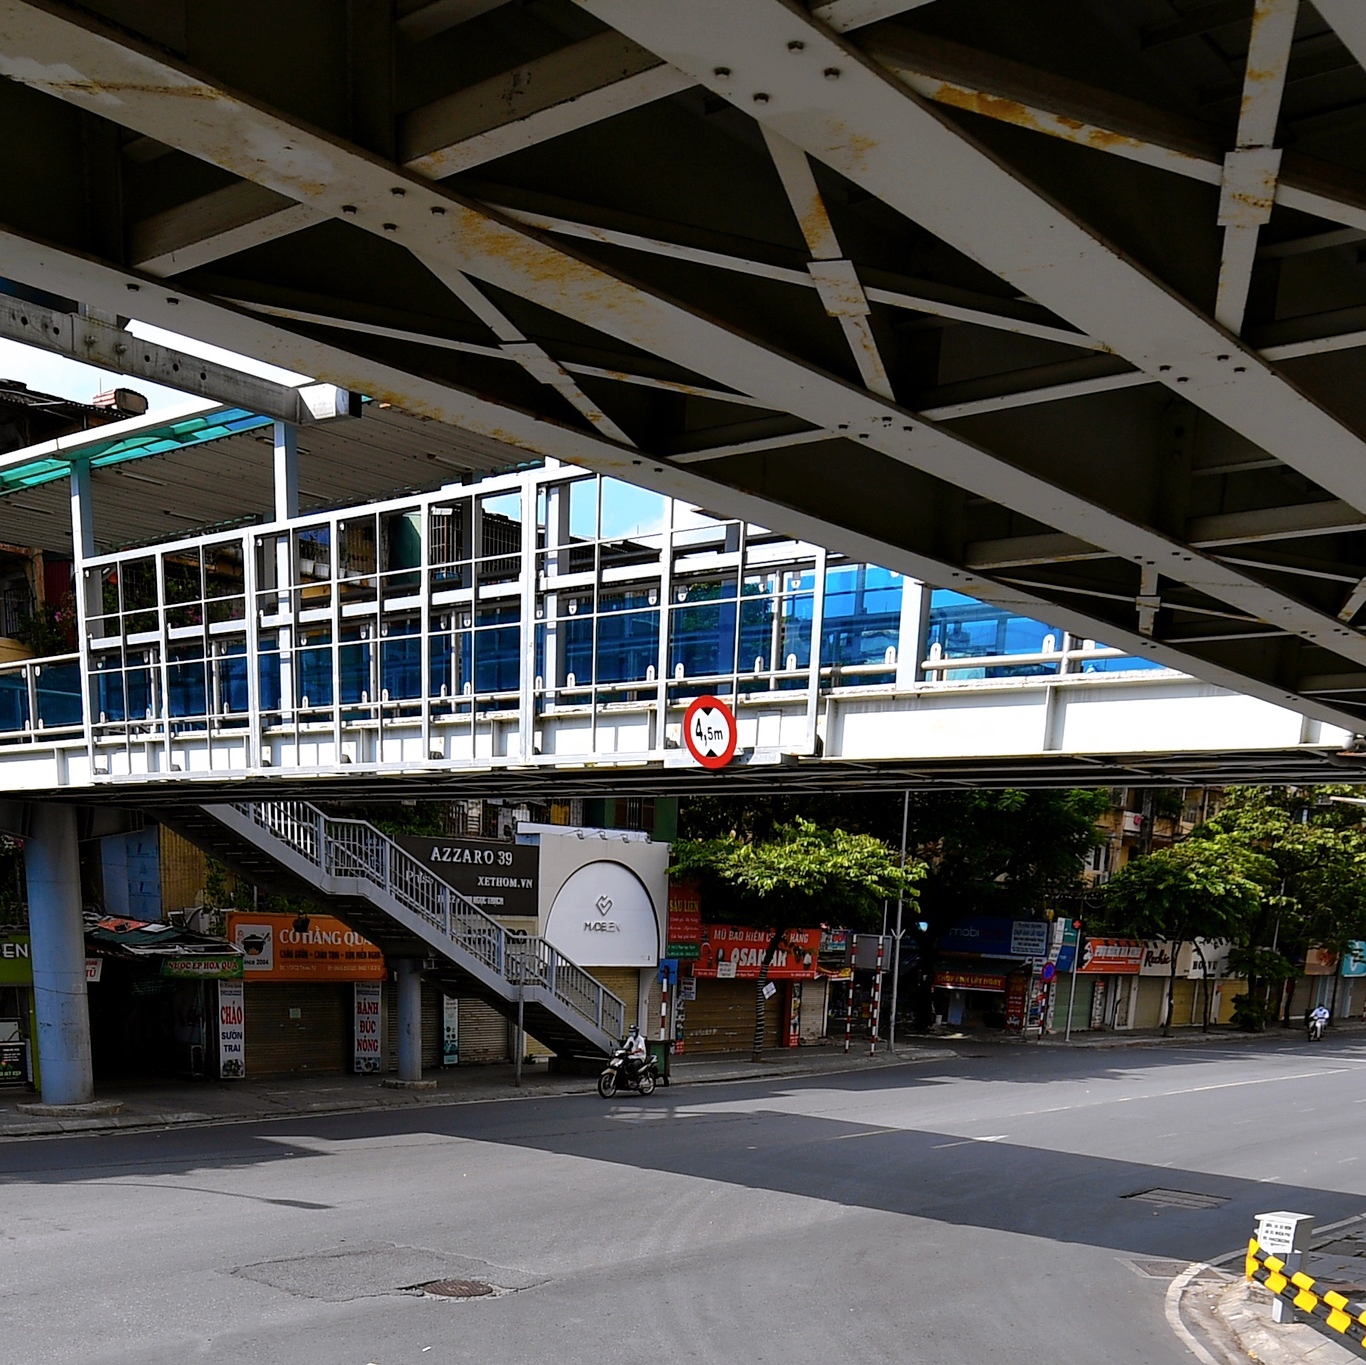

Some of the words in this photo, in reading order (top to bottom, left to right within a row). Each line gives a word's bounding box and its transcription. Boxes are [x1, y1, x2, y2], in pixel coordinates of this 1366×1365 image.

[695, 717, 724, 747] 4,5m
[430, 846, 495, 866] AZZARO
[496, 850, 514, 867] 39
[477, 875, 534, 889] XETHOM.VN
[220, 1001, 243, 1025] CHÁO
[357, 998, 378, 1015] BÁNH
[359, 1016, 376, 1034] ĐÚC
[223, 1043, 241, 1053] TRAI
[356, 1037, 379, 1052] NÓNG
